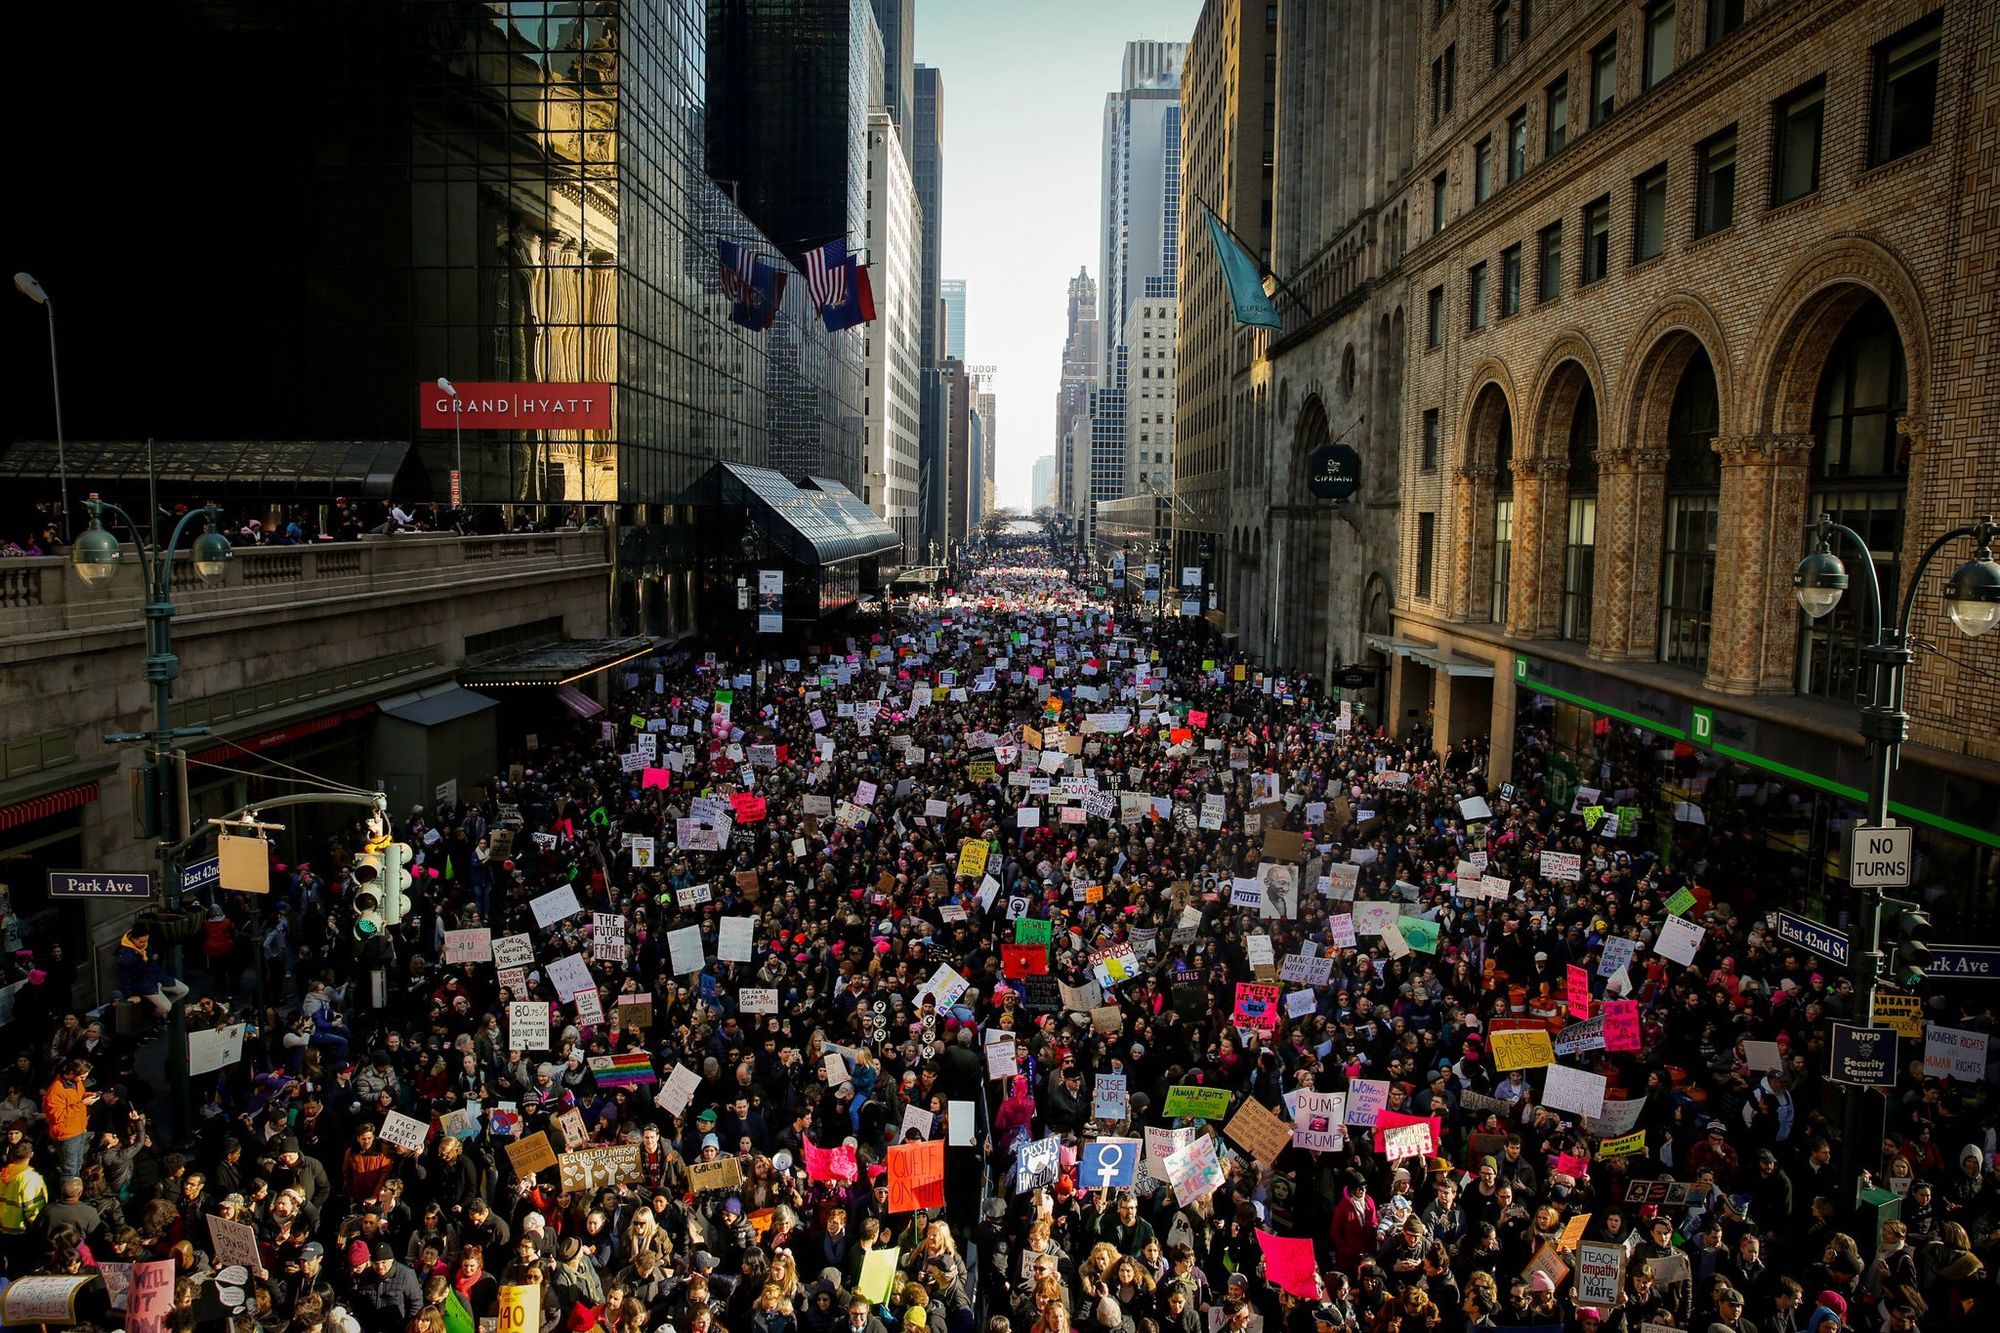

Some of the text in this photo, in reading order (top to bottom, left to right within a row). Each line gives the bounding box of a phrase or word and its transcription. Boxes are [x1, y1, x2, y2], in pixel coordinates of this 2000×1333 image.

[967, 365, 998, 373] TUDOR
[435, 399, 594, 413] GRAND HYATT
[1695, 713, 1709, 737] TD
[1869, 838, 1894, 854] NO
[1855, 862, 1906, 876] TURNS
[184, 869, 202, 887] East
[68, 879, 134, 893] Park Ave
[678, 889, 697, 902] RISE
[599, 914, 619, 927] THE
[1675, 919, 1698, 932] BELIEVE
[595, 926, 625, 938] FUTURE
[1781, 918, 1846, 961] East 42nd St
[494, 940, 507, 953] STOP
[594, 943, 624, 960] FEMALE
[499, 955, 512, 964] ROE
[1088, 941, 1132, 967] REMEMBER
[1287, 955, 1330, 967] DANCING
[1954, 957, 1989, 973] Ave
[500, 970, 522, 979] RESPECT
[1177, 971, 1199, 981] GIRLS
[1284, 963, 1325, 976] WITH THE
[1290, 972, 1323, 984] TSARS
[576, 992, 597, 1001] GIRLS
[1242, 984, 1276, 997] TWEETS
[1875, 996, 1919, 1008] ANSANS
[1237, 1013, 1268, 1024] RESPECT
[511, 1028, 548, 1038] DID NOT VOTE
[1502, 1033, 1534, 1046] WERE
[1851, 1031, 1881, 1042] NYPD
[1959, 1035, 1986, 1051] RIGHTS
[1496, 1042, 1551, 1070] PISSED
[1843, 1057, 1885, 1070] Security
[1925, 1055, 1982, 1074] HUMAN RIGHTS
[1844, 1067, 1885, 1078] Camera
[1097, 1079, 1124, 1090] RISE
[1101, 1091, 1118, 1102] UP!
[1172, 1087, 1225, 1100] HUMAN RIGHTS
[1297, 1095, 1343, 1113] DUMP
[1347, 1110, 1378, 1125] RIGHT
[395, 1118, 417, 1132] FACT
[389, 1126, 417, 1141] BASED
[1149, 1127, 1169, 1139] NEVER
[382, 1131, 419, 1149] REALITY
[1294, 1131, 1342, 1149] TRUMP
[1603, 1135, 1642, 1148] EQUALITY
[1021, 1137, 1059, 1166] PUSSIES
[1614, 1145, 1631, 1153] FOR
[596, 1155, 636, 1166] INCLUSION
[882, 1145, 937, 1179] QUEEF
[1019, 1169, 1040, 1191] HAVE
[881, 1180, 907, 1205] ON
[1582, 1251, 1619, 1265] TEACH
[1582, 1263, 1619, 1280] empathy
[133, 1267, 170, 1290] WILL
[1583, 1274, 1607, 1287] NOT
